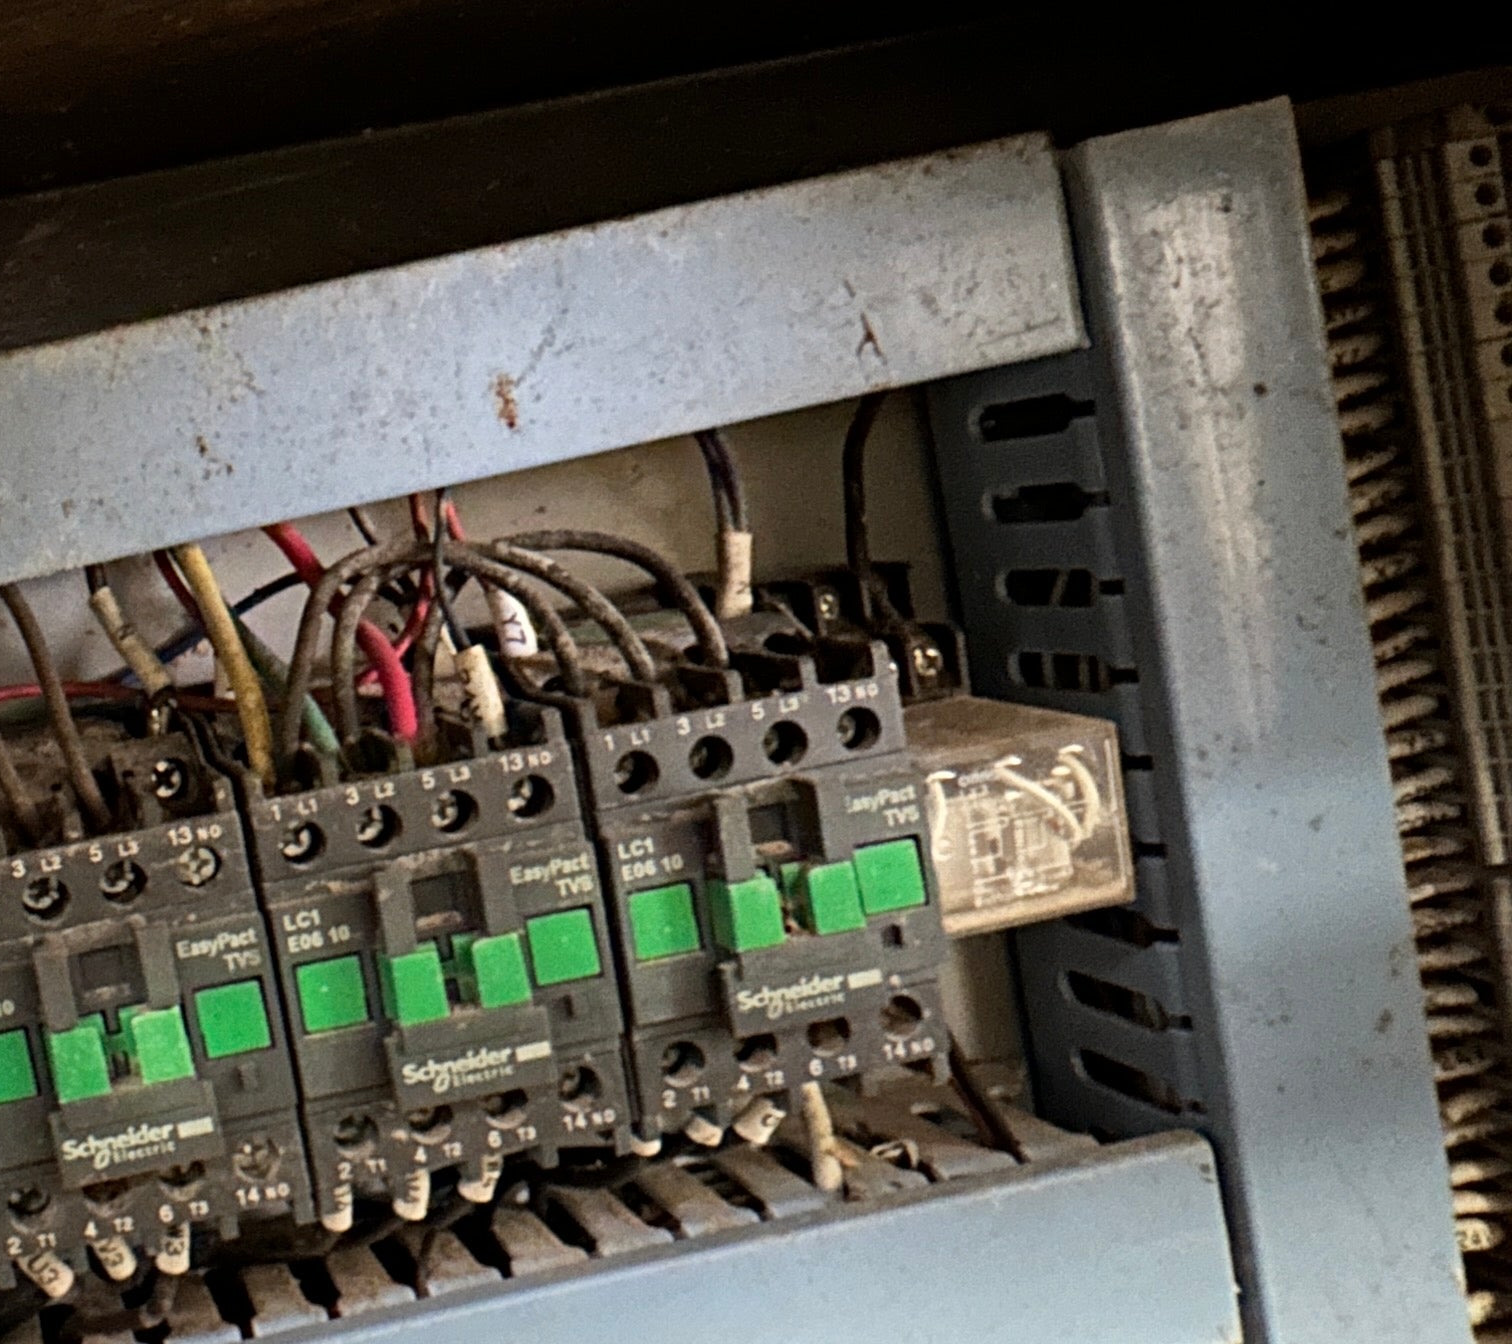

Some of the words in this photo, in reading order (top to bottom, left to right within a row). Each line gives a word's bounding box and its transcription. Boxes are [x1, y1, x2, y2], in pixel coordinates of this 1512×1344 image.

[502, 611, 527, 645] Y7
[825, 684, 851, 704] 13
[752, 702, 765, 720] 5
[779, 696, 799, 713] L3
[677, 716, 691, 735] 3
[705, 713, 726, 729] L2
[604, 734, 614, 751] 1
[631, 729, 650, 746] L1
[498, 753, 523, 772] 13
[422, 771, 436, 790] 5
[449, 766, 471, 783] L3
[346, 787, 360, 805] 3
[375, 782, 395, 799] L2
[271, 804, 281, 822] 1
[298, 798, 317, 815] L1
[167, 826, 193, 846] 13
[89, 844, 103, 863] 5
[118, 840, 139, 857] L3
[617, 837, 655, 860] LC1
[11, 859, 27, 878] 3
[41, 855, 62, 872] L2
[510, 853, 589, 885] EasyPact
[661, 854, 684, 873] 10
[283, 909, 320, 932] LC1
[175, 928, 258, 959] EasyPact
[327, 924, 351, 944] 10
[737, 973, 845, 1020] Schneider
[883, 1039, 906, 1061] 14
[402, 1046, 513, 1094] Schneider
[809, 1058, 824, 1076] 6
[737, 1075, 750, 1091] 4
[661, 1089, 677, 1108] 2
[563, 1111, 587, 1132] 14
[61, 1123, 175, 1170] Schneider
[488, 1130, 502, 1148] 6
[414, 1146, 427, 1163] 4
[338, 1162, 354, 1180] 2
[236, 1186, 260, 1207] 14
[159, 1204, 174, 1223] 6
[84, 1221, 98, 1238] 4
[6, 1236, 23, 1256] 2
[28, 1255, 60, 1285] U3
